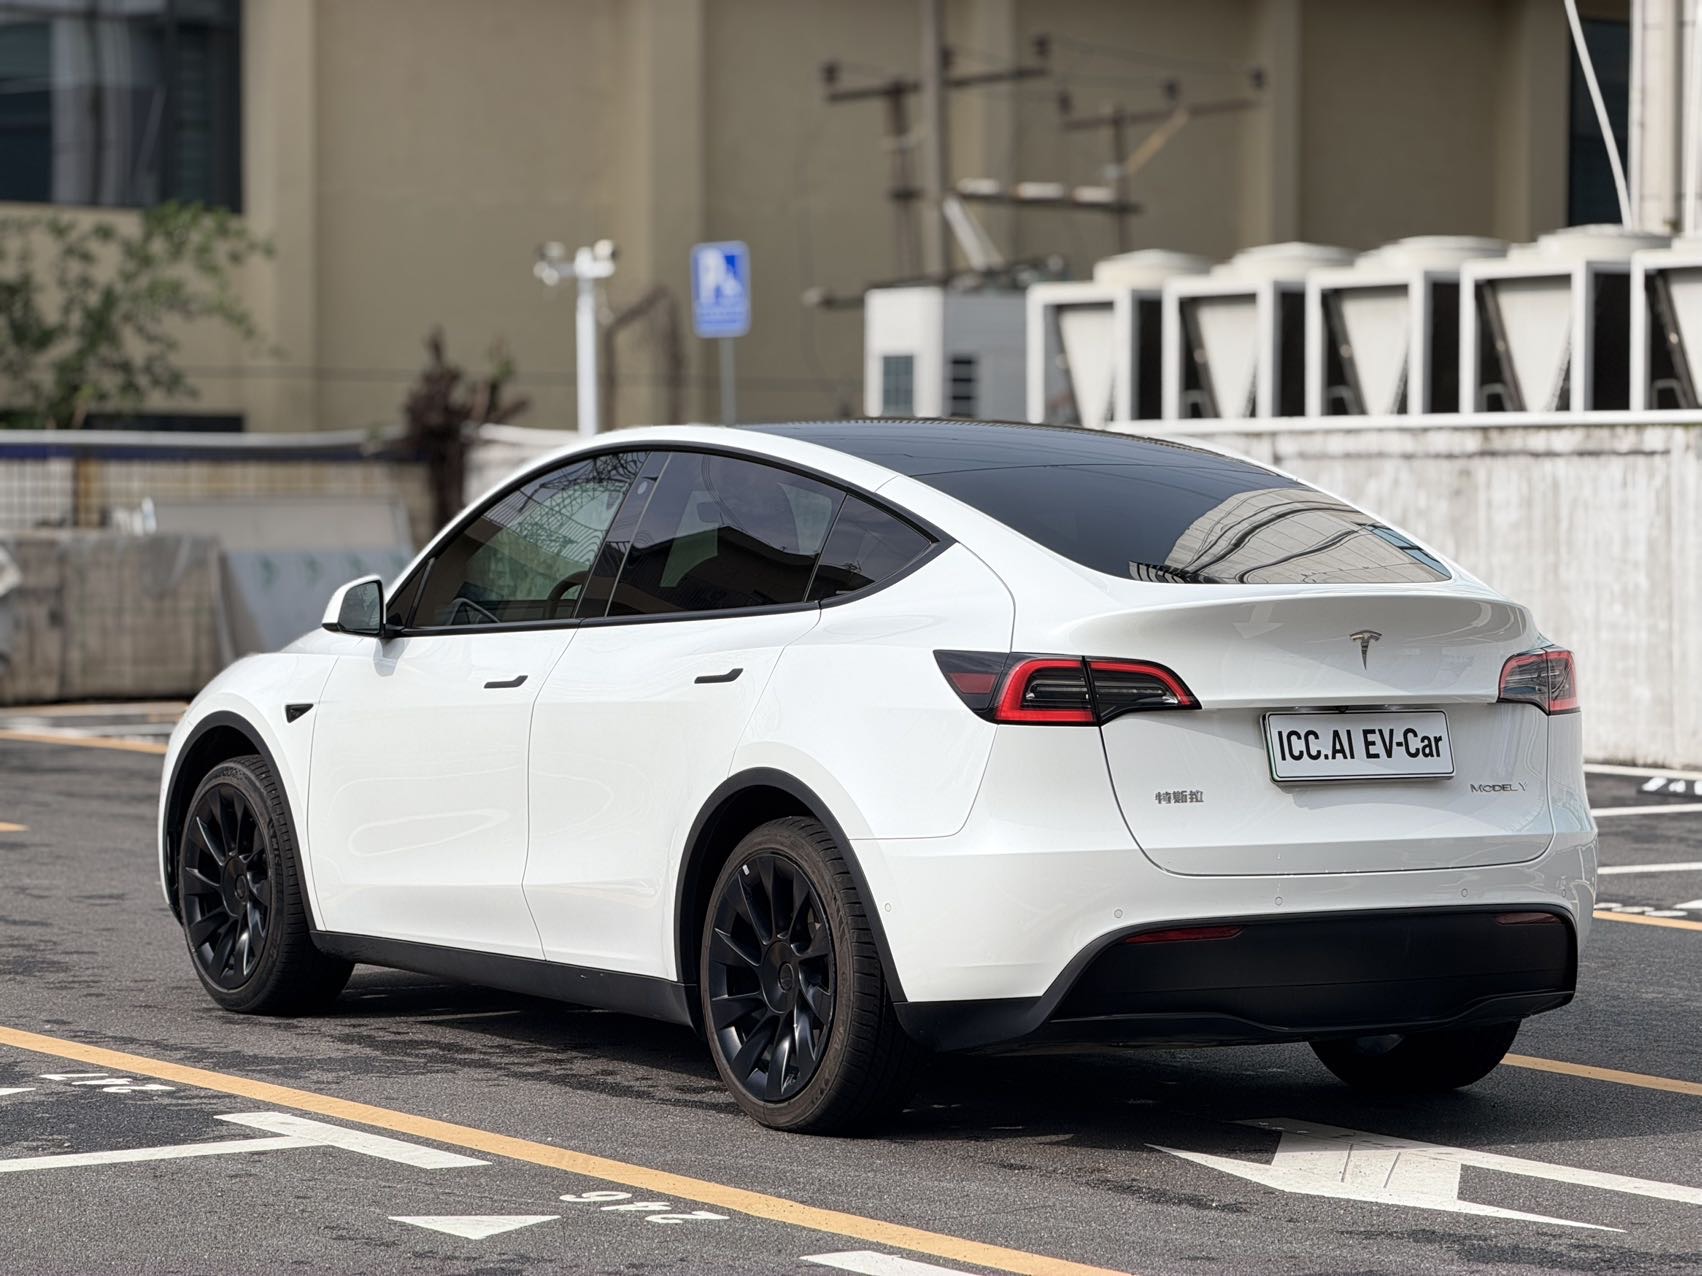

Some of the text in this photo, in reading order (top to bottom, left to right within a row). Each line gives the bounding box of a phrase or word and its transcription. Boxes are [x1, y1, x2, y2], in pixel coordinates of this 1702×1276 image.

[1277, 727, 1443, 761] ICC.AI EV-Car
[1470, 781, 1527, 793] MODEL Y
[1154, 790, 1205, 804] 特斯拉
